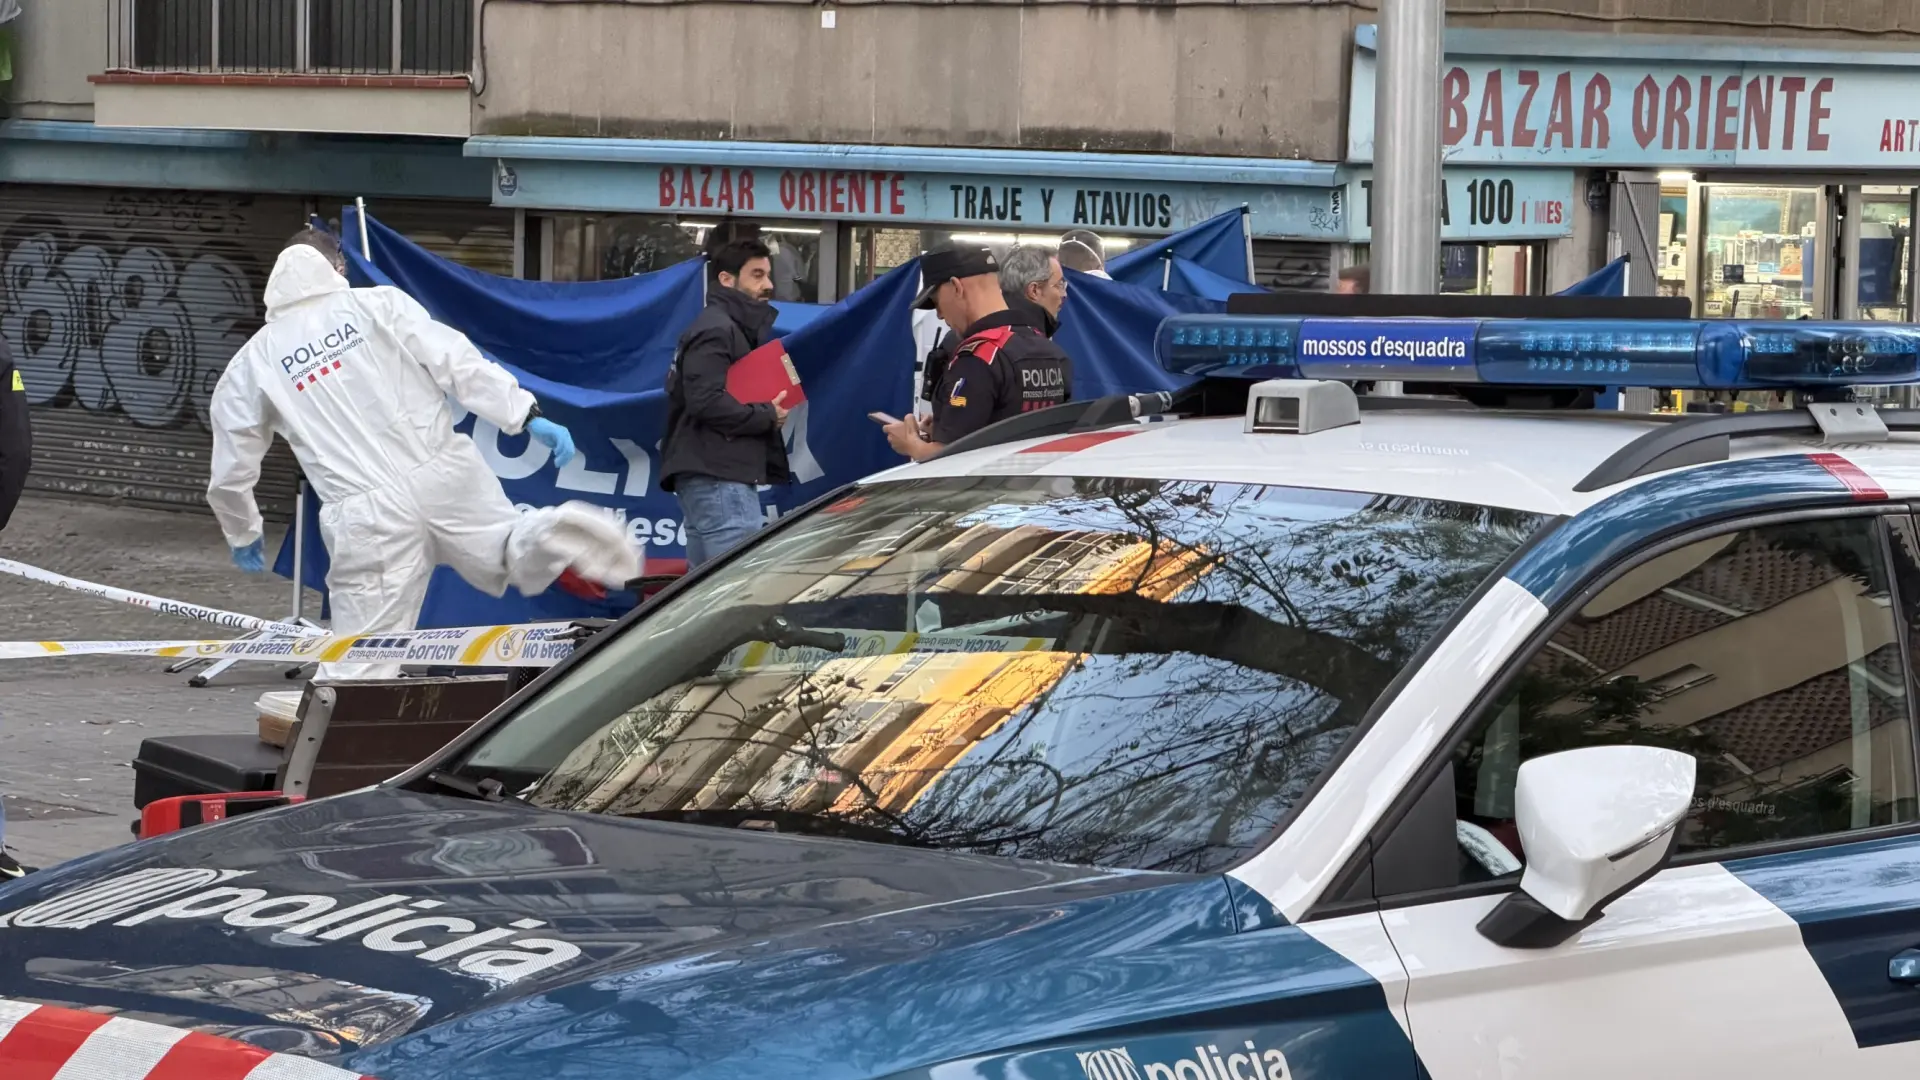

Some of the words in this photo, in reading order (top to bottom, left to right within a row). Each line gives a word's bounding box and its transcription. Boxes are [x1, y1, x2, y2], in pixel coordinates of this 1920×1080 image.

[1443, 66, 1612, 149] BAZAR
[1632, 72, 1835, 151] ORIENTE
[1879, 118, 1920, 152] ART
[658, 165, 755, 211] BAZAR
[780, 169, 905, 215] ORIENTE
[950, 183, 1023, 222] TRAJE
[1039, 187, 1056, 224] Y
[1073, 188, 1172, 228] ATAVIOS
[1466, 178, 1514, 226] 100
[1534, 200, 1562, 224] MES
[280, 322, 359, 374] POLICIA
[1303, 338, 1367, 357] mossos
[1370, 335, 1466, 362] d'esquadra
[291, 360, 321, 383] mossos
[1021, 367, 1065, 387] POLICIA
[1707, 796, 1777, 816] d'esquadra
[113, 886, 583, 986] policia
